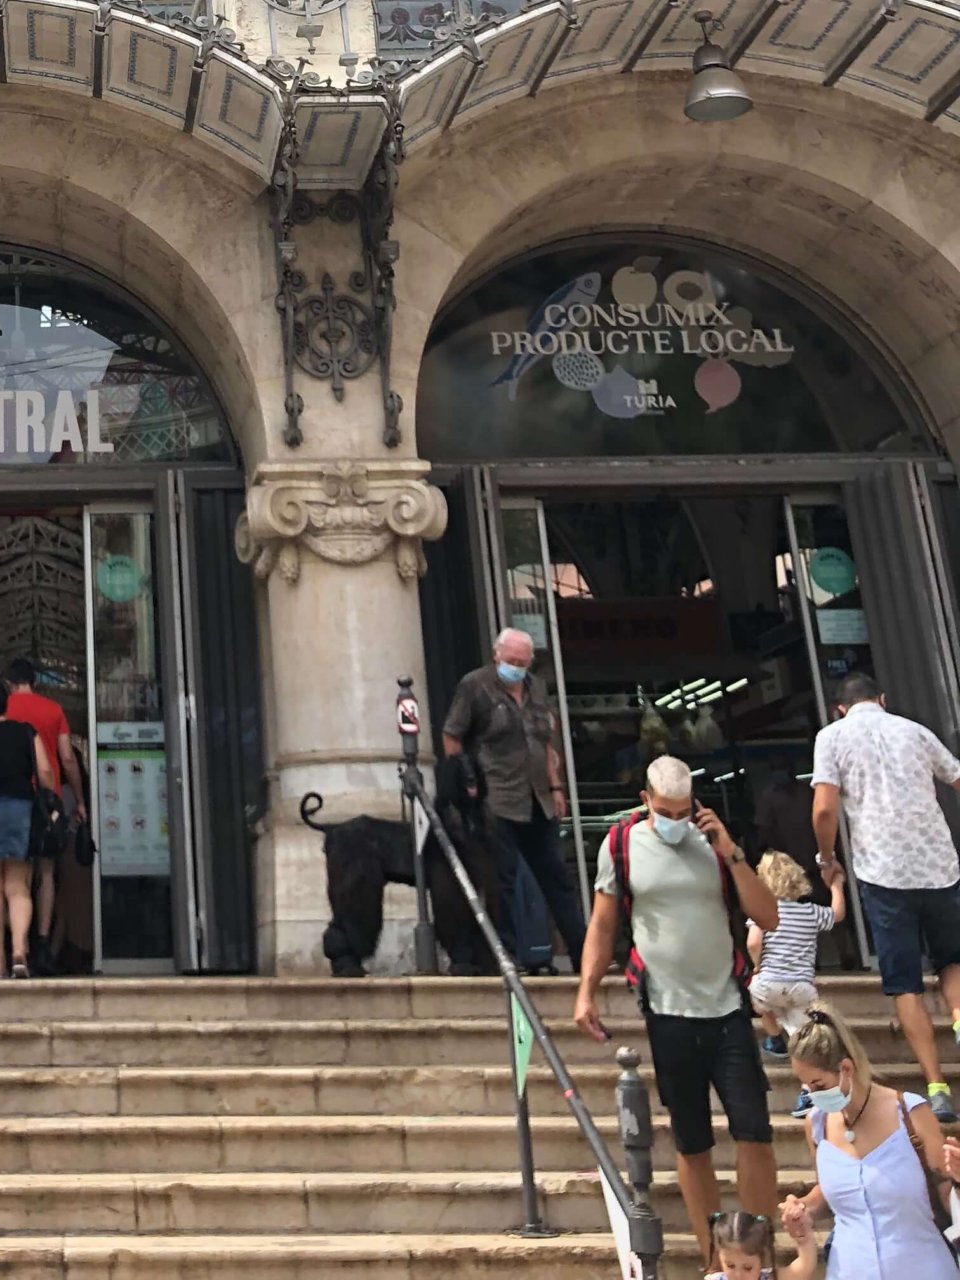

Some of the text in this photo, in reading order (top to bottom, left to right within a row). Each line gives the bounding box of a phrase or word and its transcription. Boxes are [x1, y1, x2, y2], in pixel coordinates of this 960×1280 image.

[543, 302, 732, 327] CONSUMIX
[491, 328, 795, 356] PRODUCTE LOCAL
[623, 395, 677, 409] TURIA
